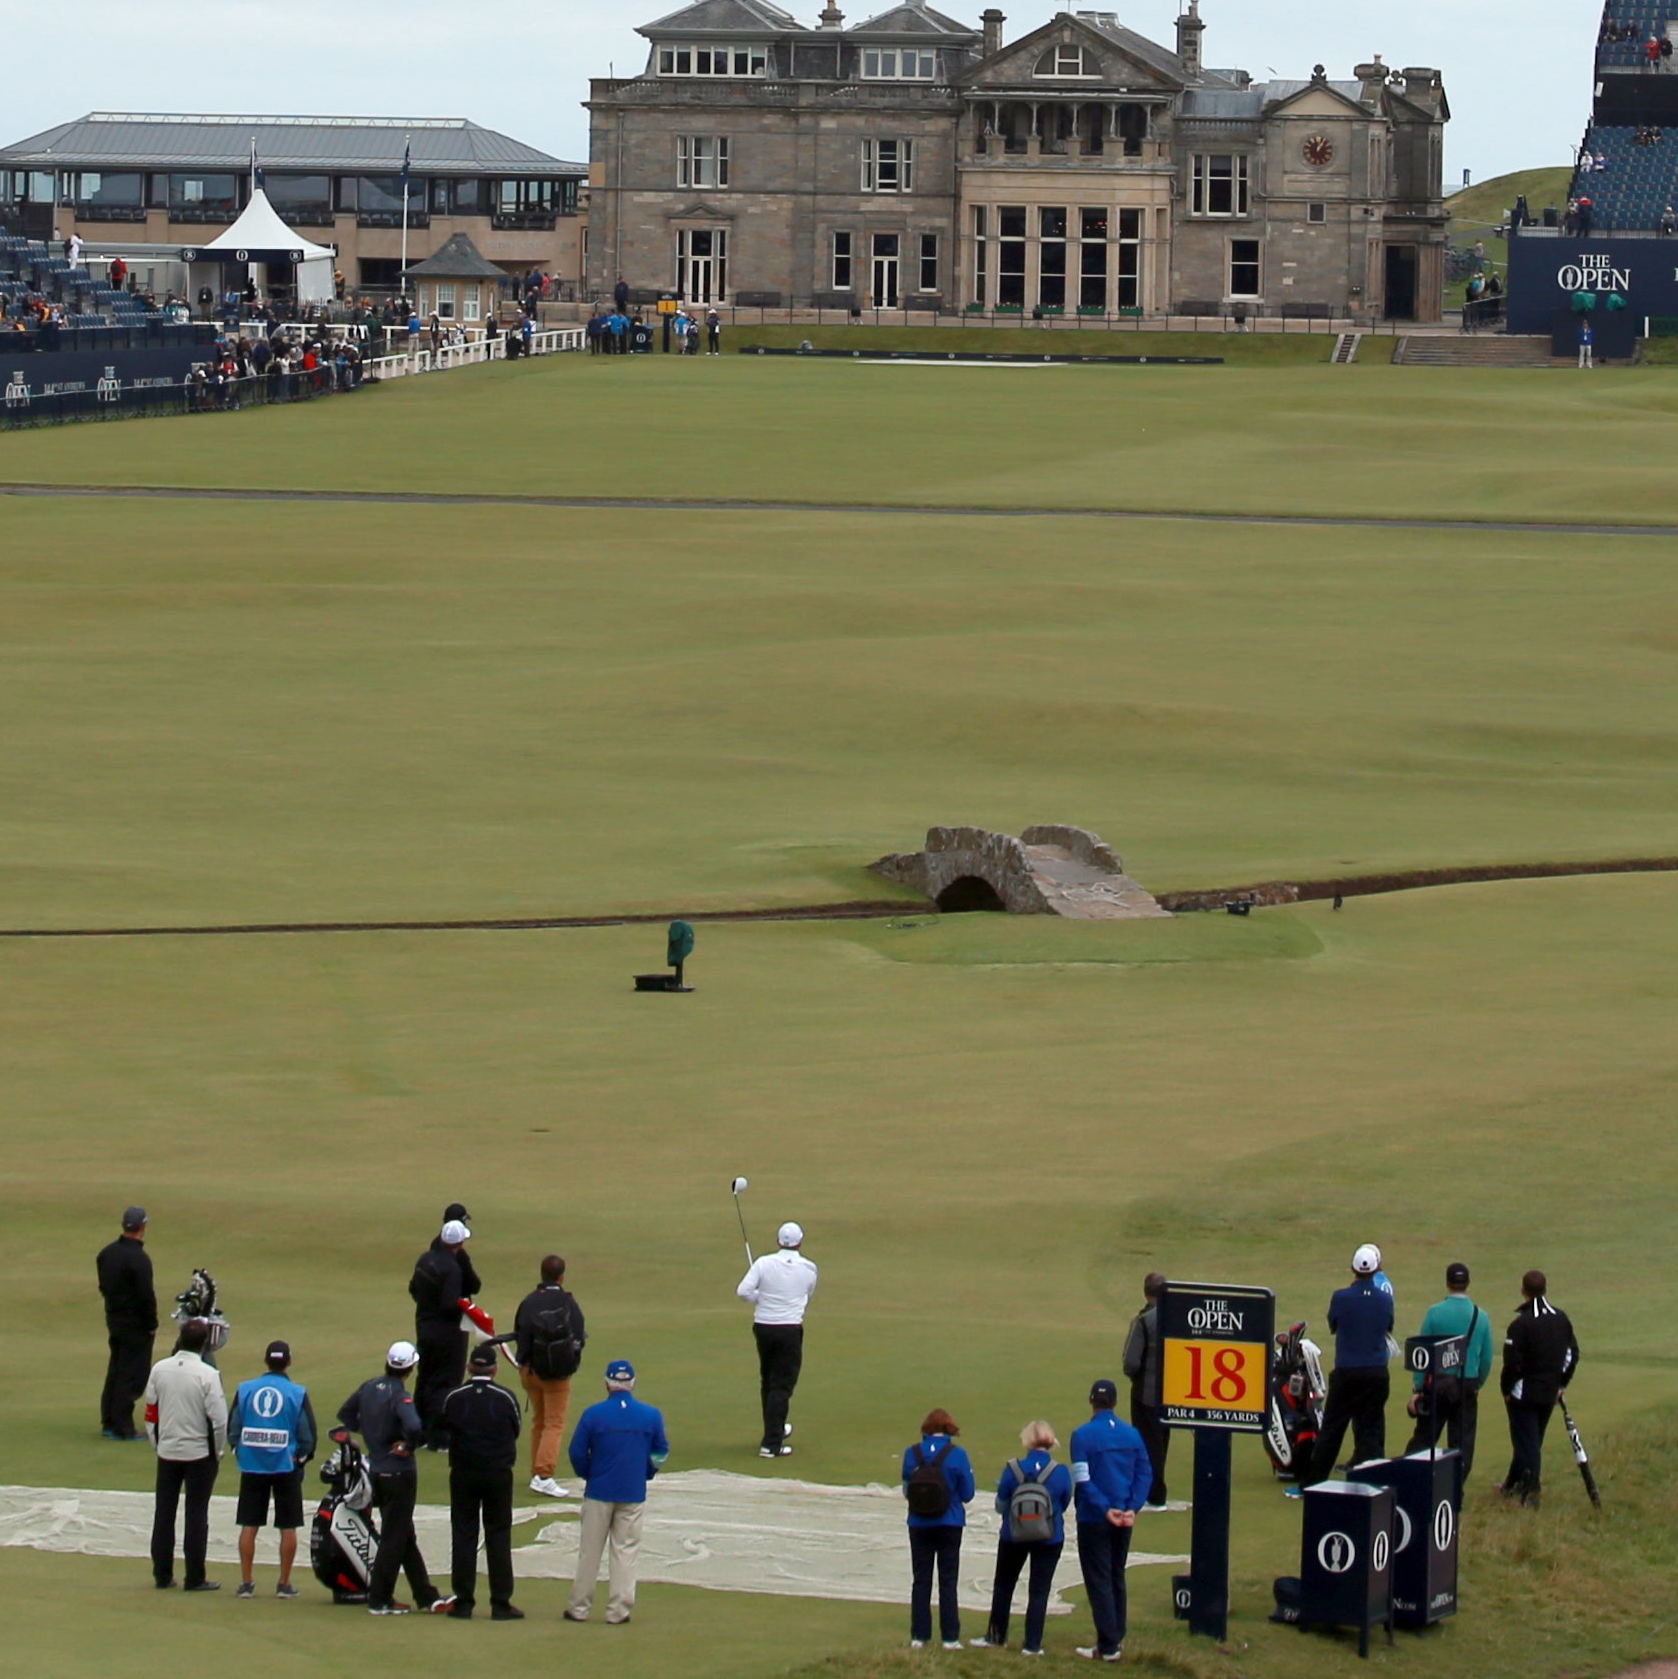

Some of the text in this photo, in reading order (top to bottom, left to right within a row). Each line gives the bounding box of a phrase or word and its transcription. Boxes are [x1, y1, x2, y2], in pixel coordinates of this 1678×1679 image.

[1579, 254, 1610, 267] THE
[1557, 265, 1631, 291] OPEN
[1204, 1299, 1228, 1311] THE
[1188, 1307, 1244, 1330] OPEN
[1185, 1346, 1246, 1402] 18
[1168, 1407, 1260, 1422] PAR 4 356 YARDS
